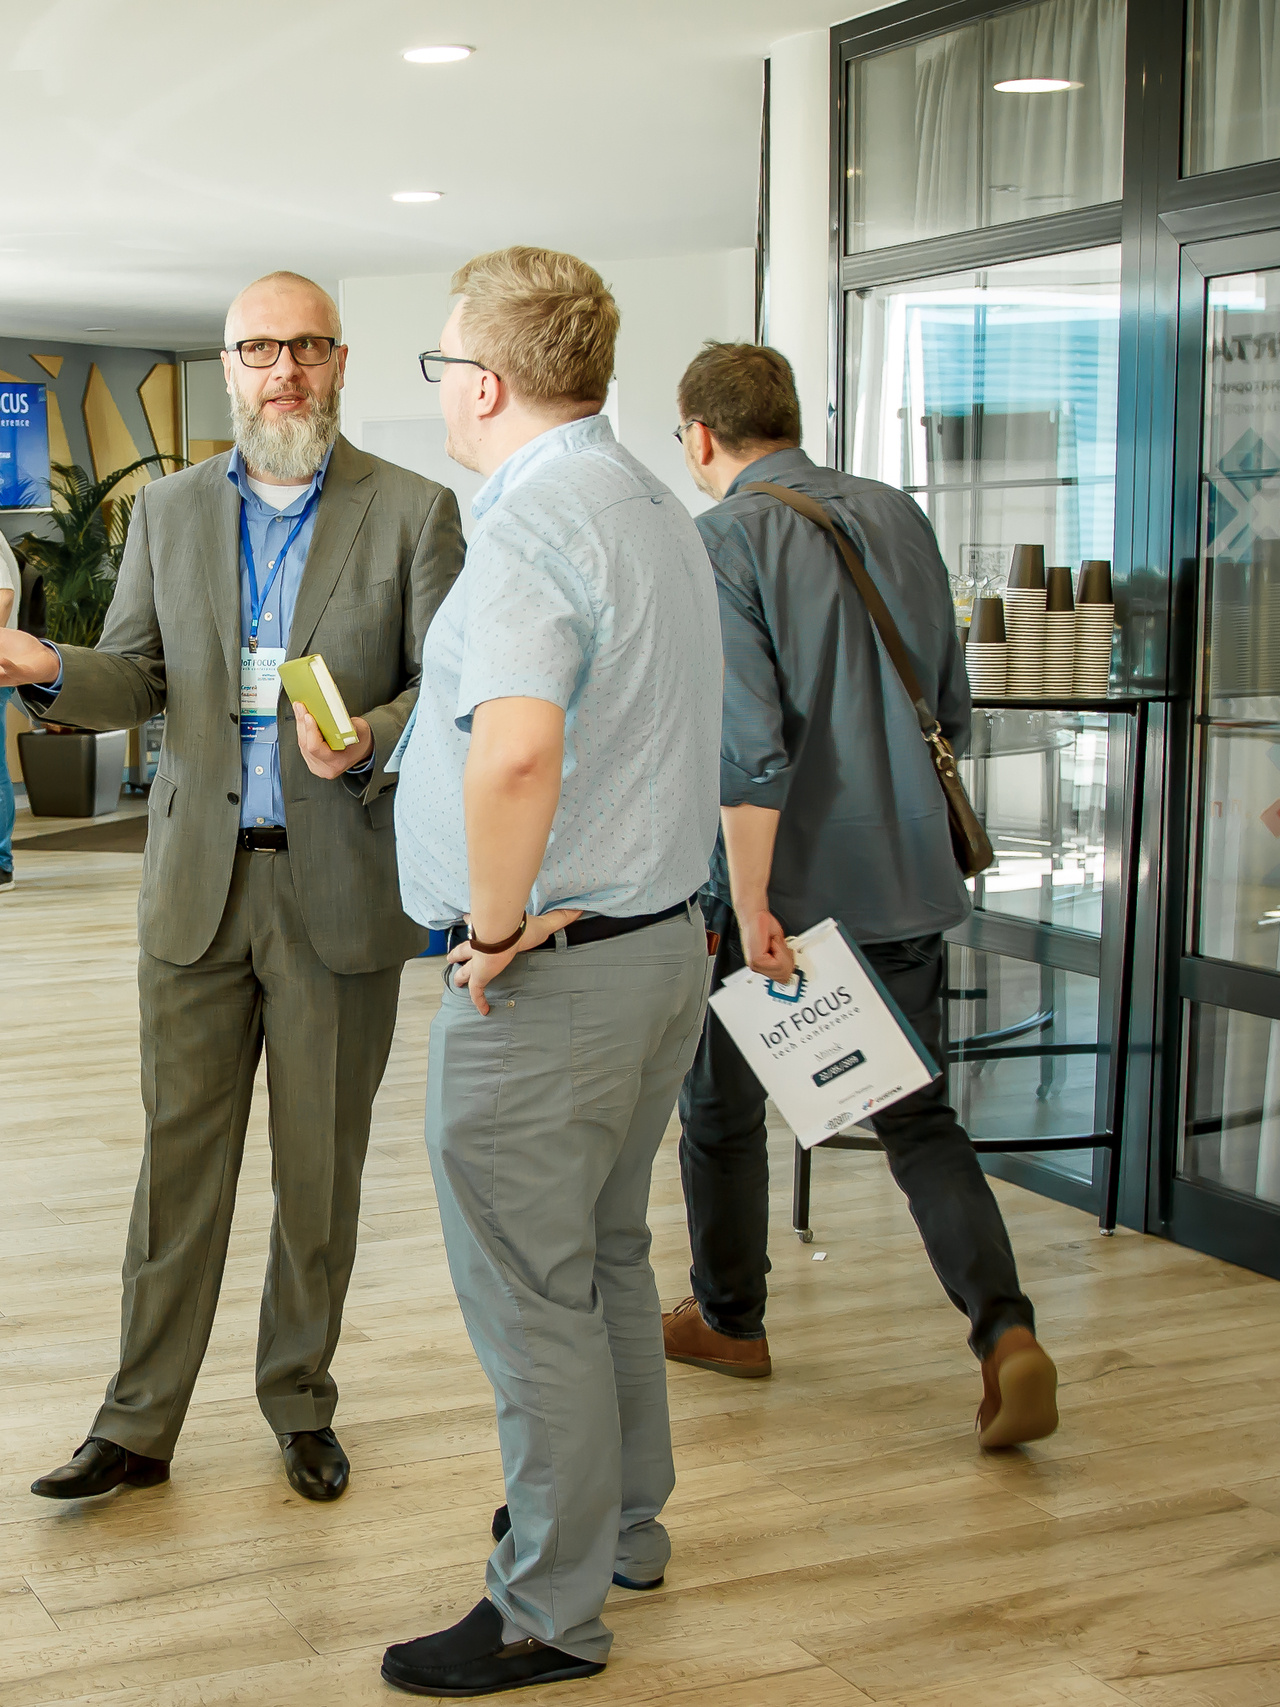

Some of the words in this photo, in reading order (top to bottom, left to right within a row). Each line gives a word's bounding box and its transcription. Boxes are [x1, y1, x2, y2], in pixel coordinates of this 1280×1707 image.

[252, 659, 277, 667] FOCUS
[759, 1021, 790, 1049] IoT
[790, 985, 853, 1032] FOCUS
[800, 1005, 861, 1044] conference
